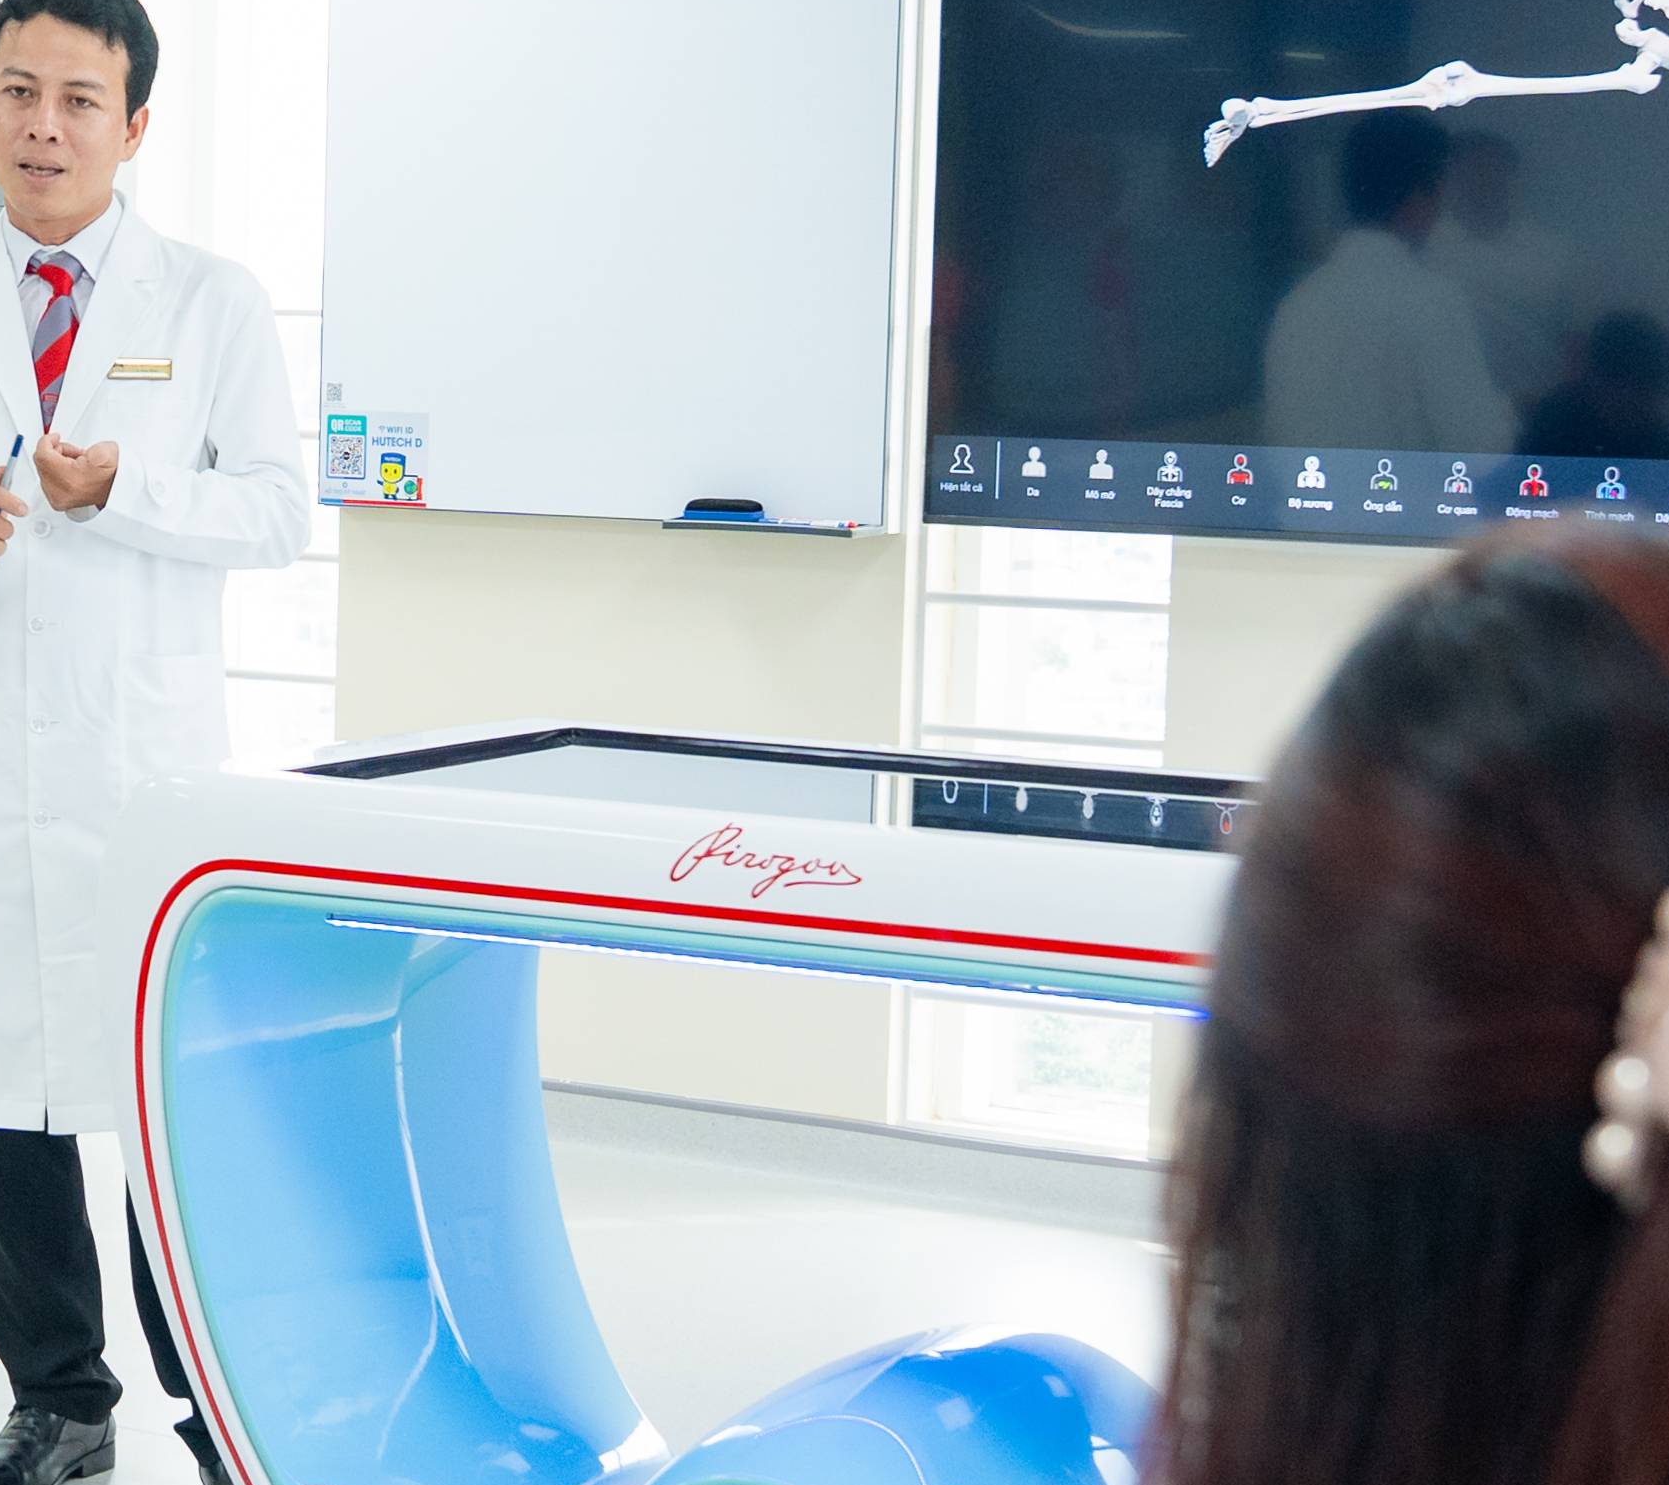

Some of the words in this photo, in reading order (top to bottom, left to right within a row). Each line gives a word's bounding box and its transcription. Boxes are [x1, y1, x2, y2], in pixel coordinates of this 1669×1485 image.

[331, 418, 345, 432] QR
[405, 426, 414, 434] ID
[371, 437, 413, 448] HUTECH
[414, 437, 423, 448] D
[1026, 487, 1040, 498] Da
[1154, 498, 1184, 509] Fascia
